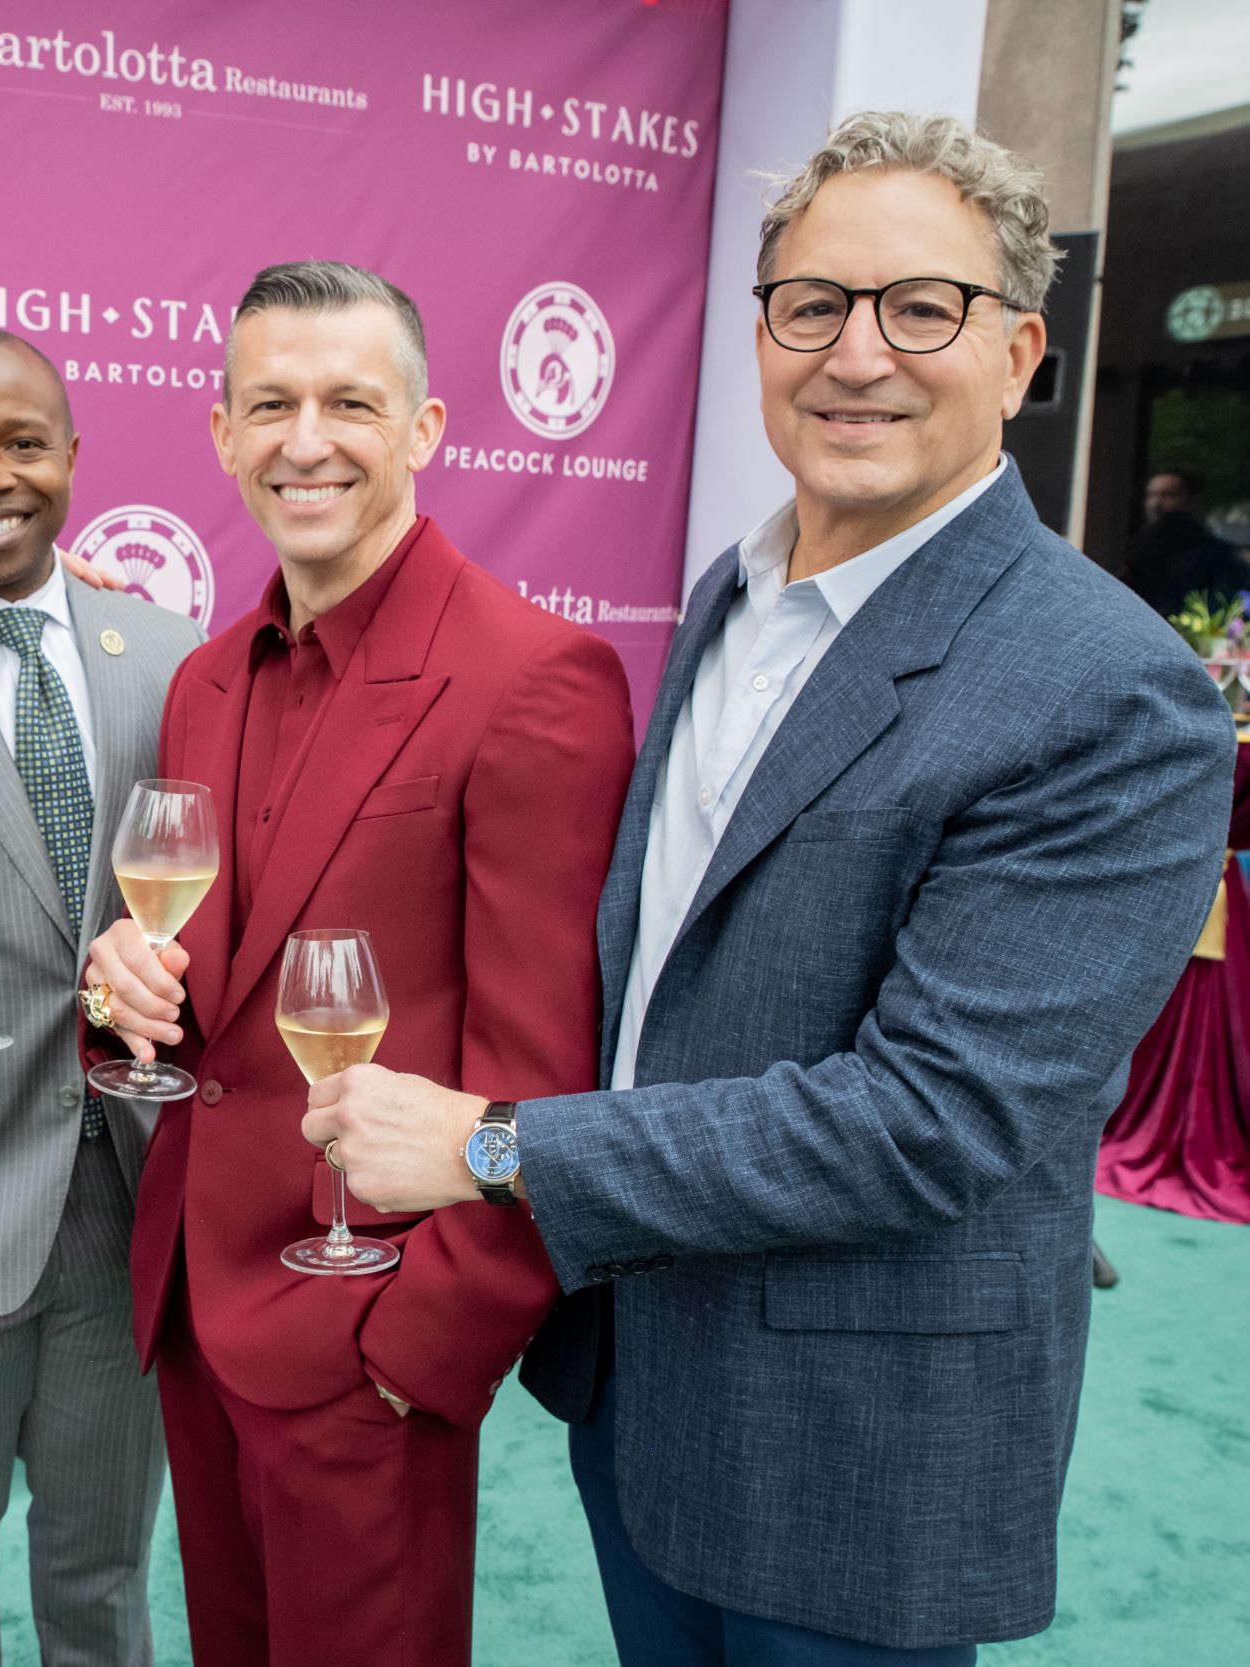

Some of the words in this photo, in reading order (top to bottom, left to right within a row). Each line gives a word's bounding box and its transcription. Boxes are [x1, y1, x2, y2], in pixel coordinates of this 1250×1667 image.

[100, 93, 138, 114] EST.
[145, 100, 182, 119] 1993
[224, 65, 369, 111] Restaurants
[422, 73, 533, 128] HIGH
[557, 97, 699, 158] STAKES
[467, 142, 497, 165] BY
[509, 148, 659, 192] BARTOLOTTA
[444, 445, 554, 474] PEACOCK
[562, 454, 648, 482] LOUNGE
